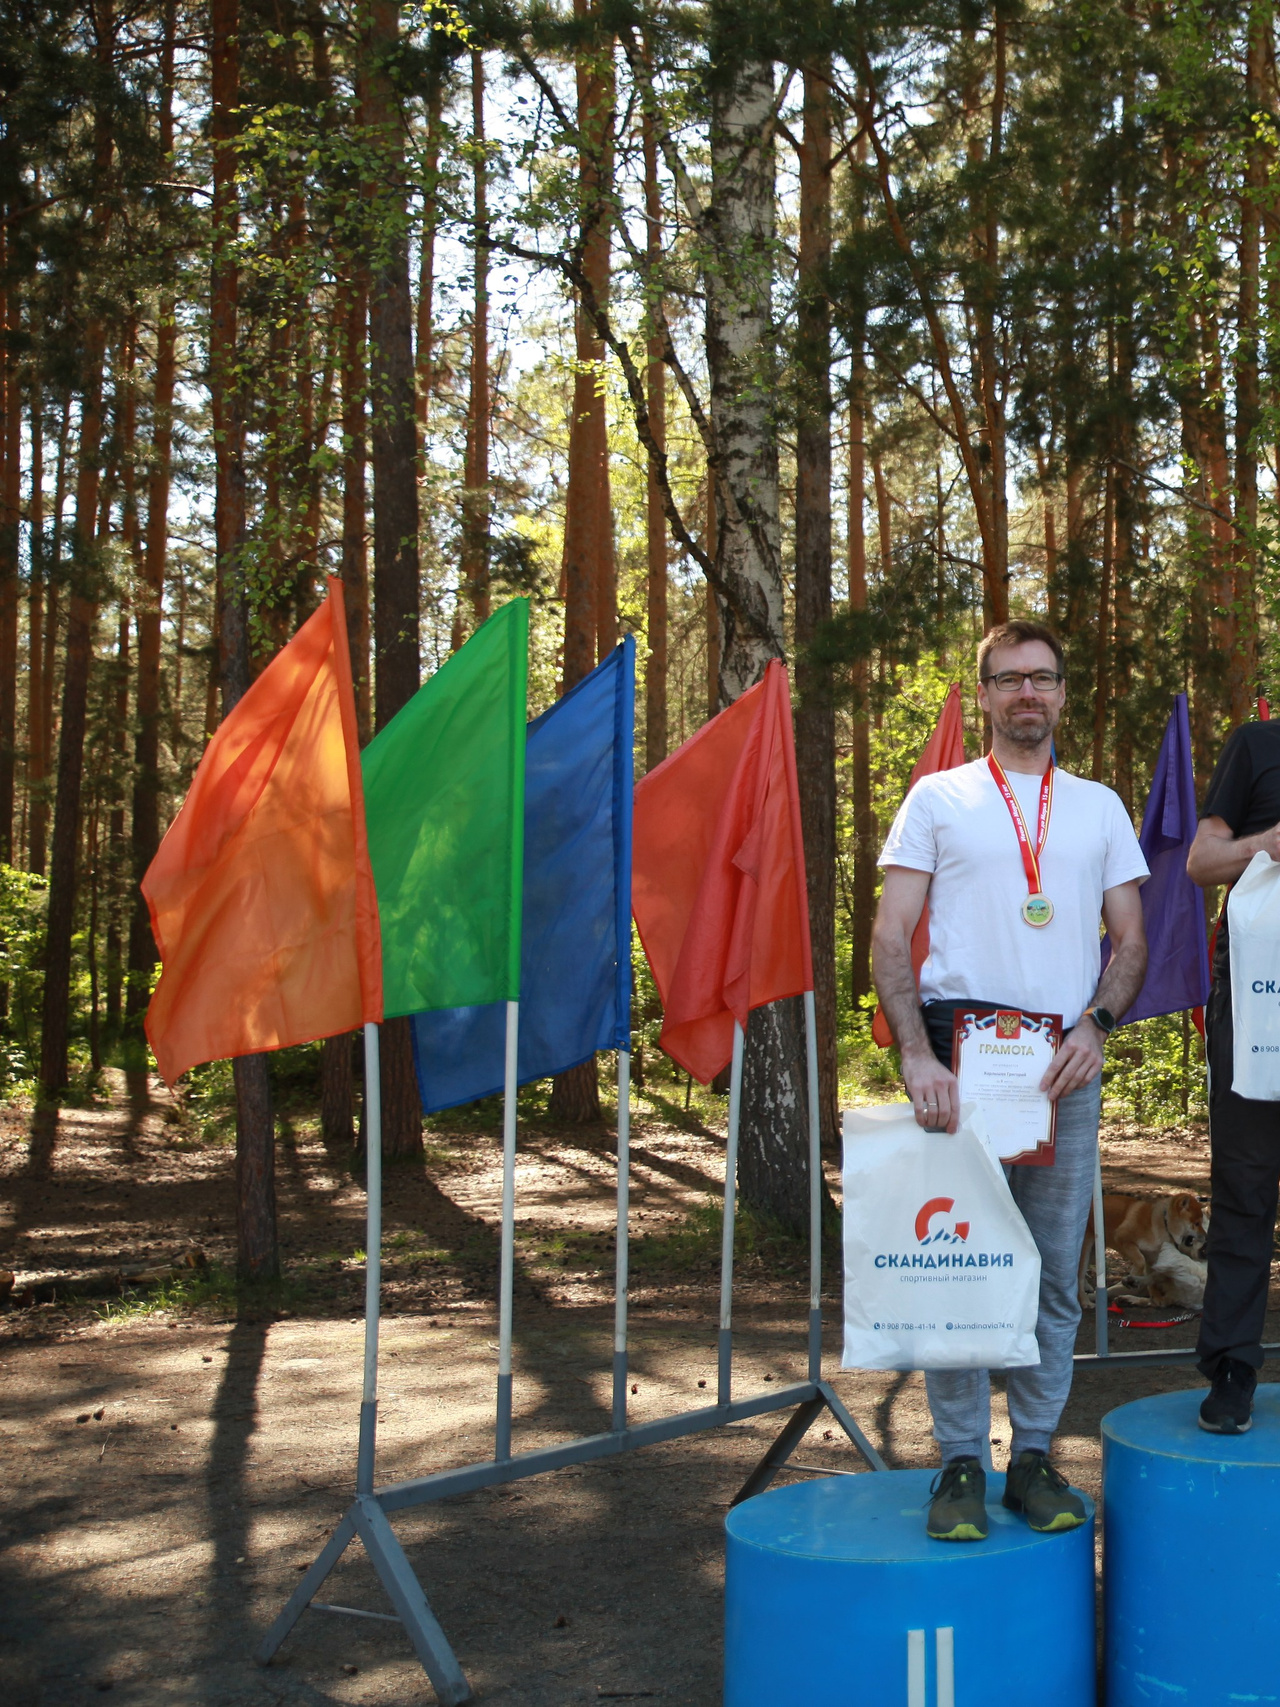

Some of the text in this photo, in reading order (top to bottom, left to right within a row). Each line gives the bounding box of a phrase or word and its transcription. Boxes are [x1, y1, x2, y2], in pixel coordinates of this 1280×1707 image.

[979, 1044, 1035, 1056] ГРАМОТА
[875, 1253, 1014, 1269] СКАНДИНАВИЯ
[900, 1274, 949, 1284] спортивный
[954, 1322, 1014, 1330] skandinavia74.ru
